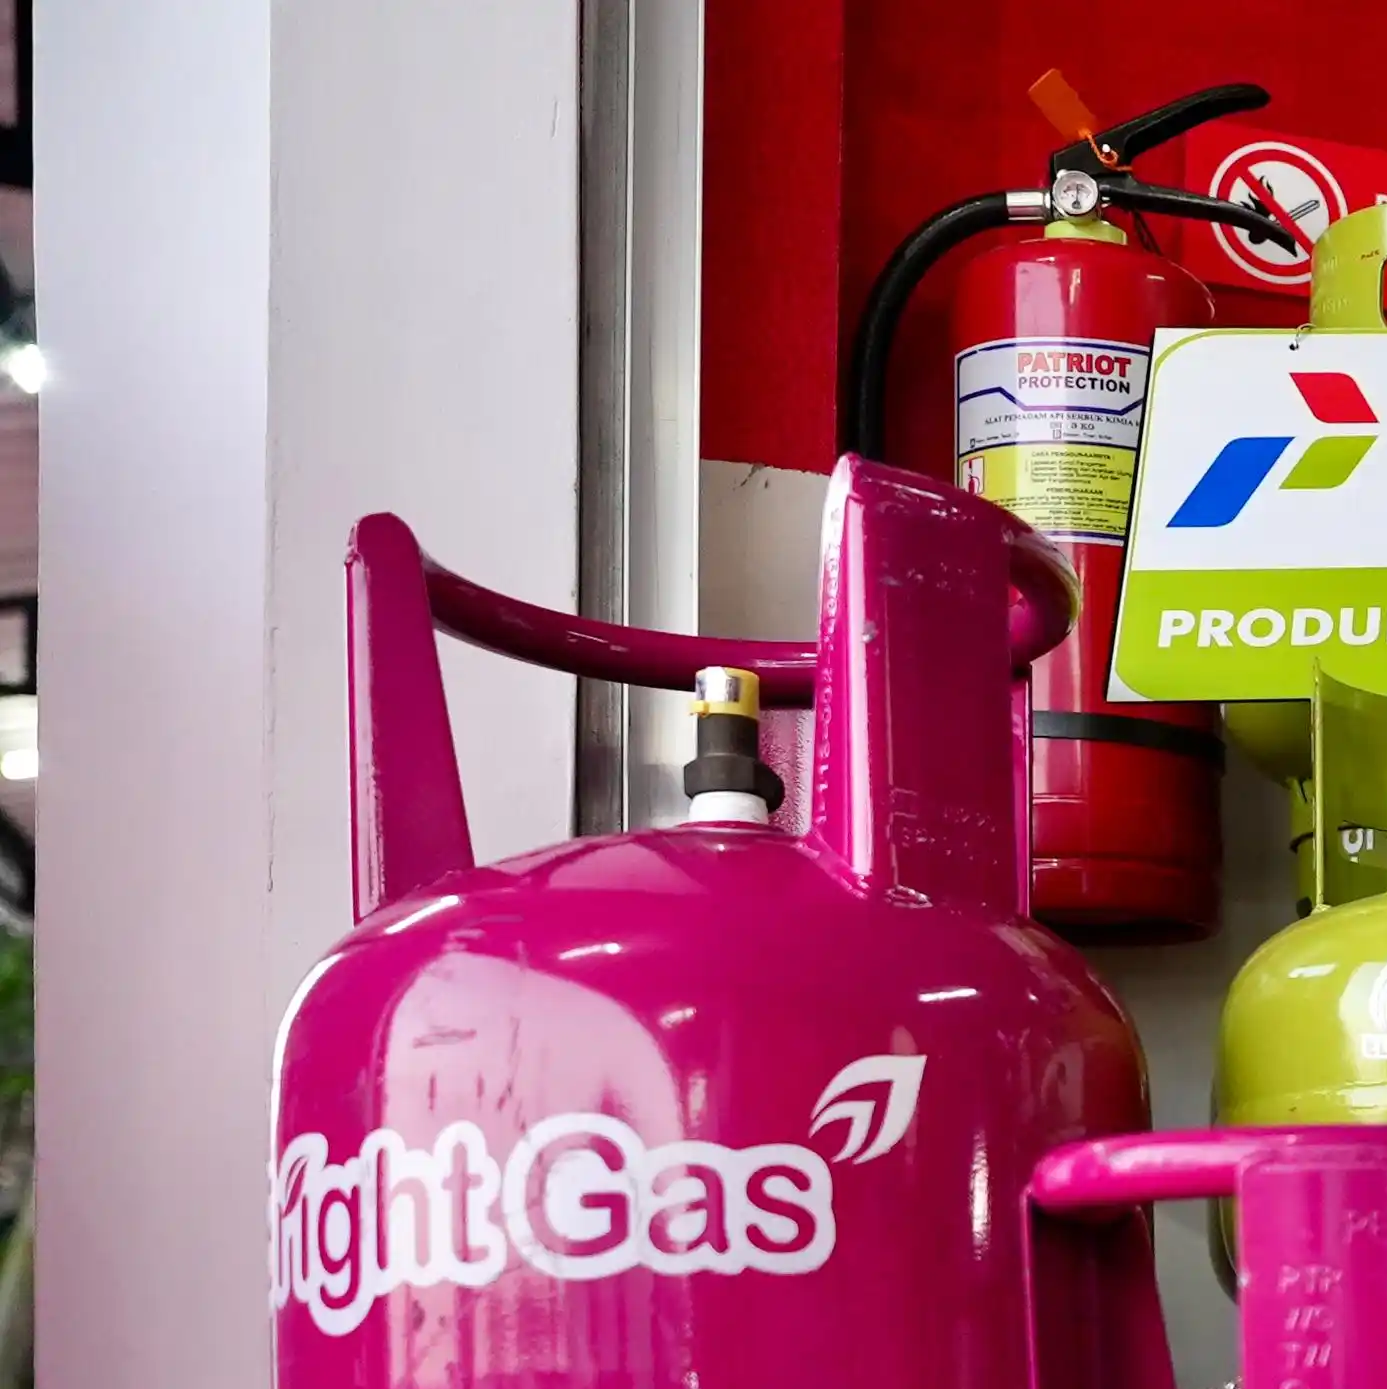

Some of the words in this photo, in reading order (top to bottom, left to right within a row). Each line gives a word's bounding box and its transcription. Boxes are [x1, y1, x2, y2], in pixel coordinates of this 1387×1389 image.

[1017, 352, 1131, 377] PATRIOT
[1018, 376, 1131, 394] PROTECTION
[1004, 412, 1047, 422] PEMADAM
[1050, 413, 1064, 421] API
[1066, 413, 1103, 422] SERBUK
[1106, 415, 1133, 426] KIMIA
[272, 1122, 507, 1335] right
[504, 1111, 836, 1281] Gas
